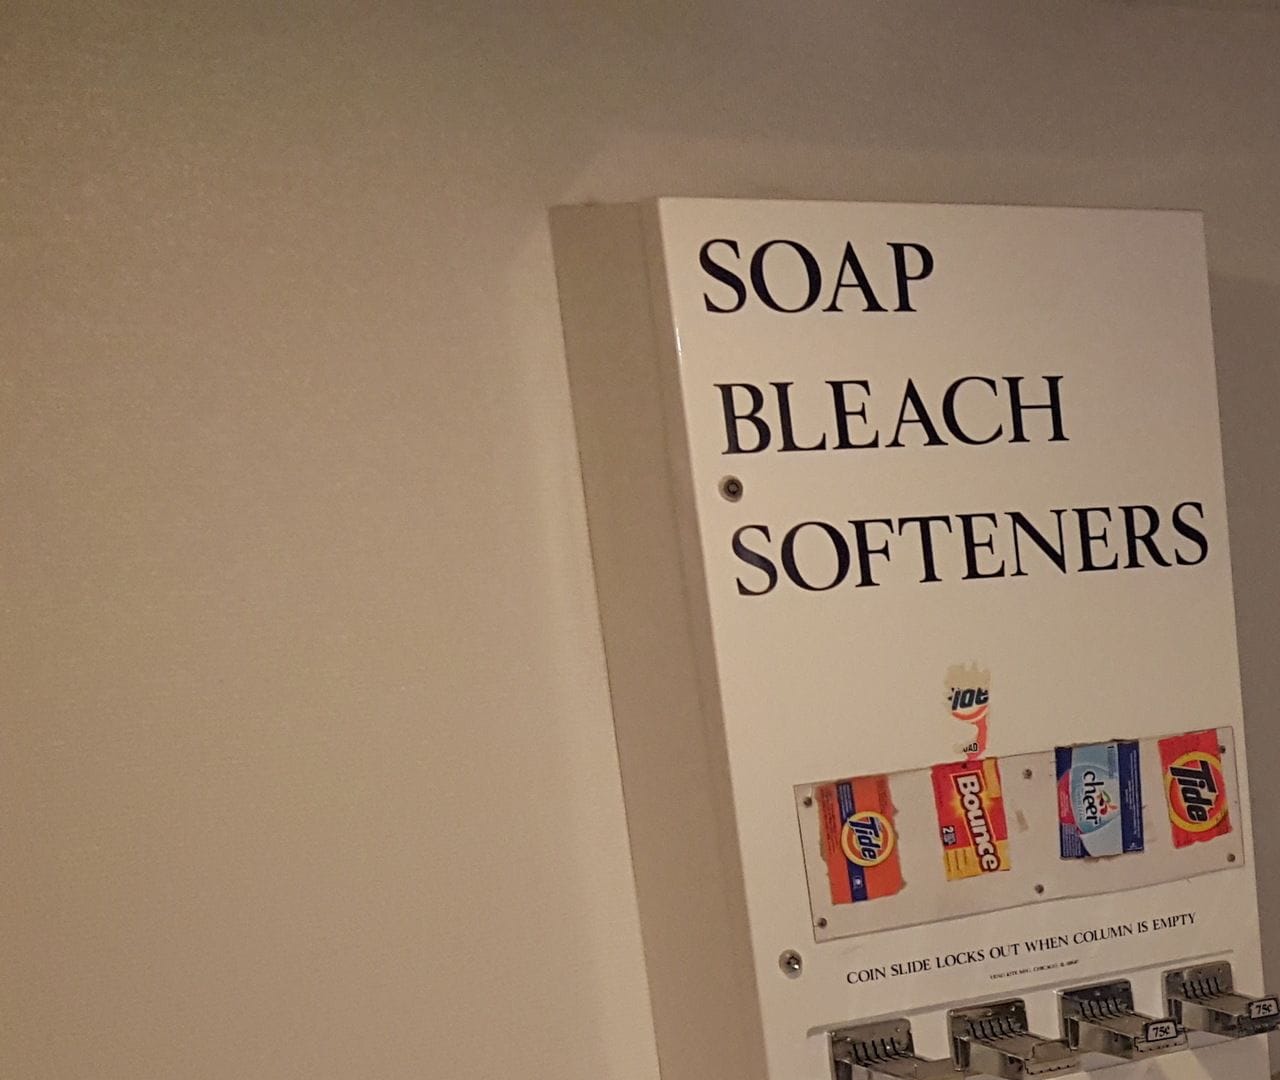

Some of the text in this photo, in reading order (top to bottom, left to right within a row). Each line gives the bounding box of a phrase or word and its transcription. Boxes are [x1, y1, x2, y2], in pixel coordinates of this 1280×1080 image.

[699, 238, 934, 314] SOAP
[714, 375, 1069, 455] BLEACH
[731, 501, 1209, 596] SOFTENERS
[957, 774, 999, 871] Bounce
[1170, 760, 1217, 822] Tide
[848, 815, 881, 860] Tide
[847, 912, 1196, 984] COIN SLIDE LOCKS OUT WHEN COLUMN IS EMPTY
